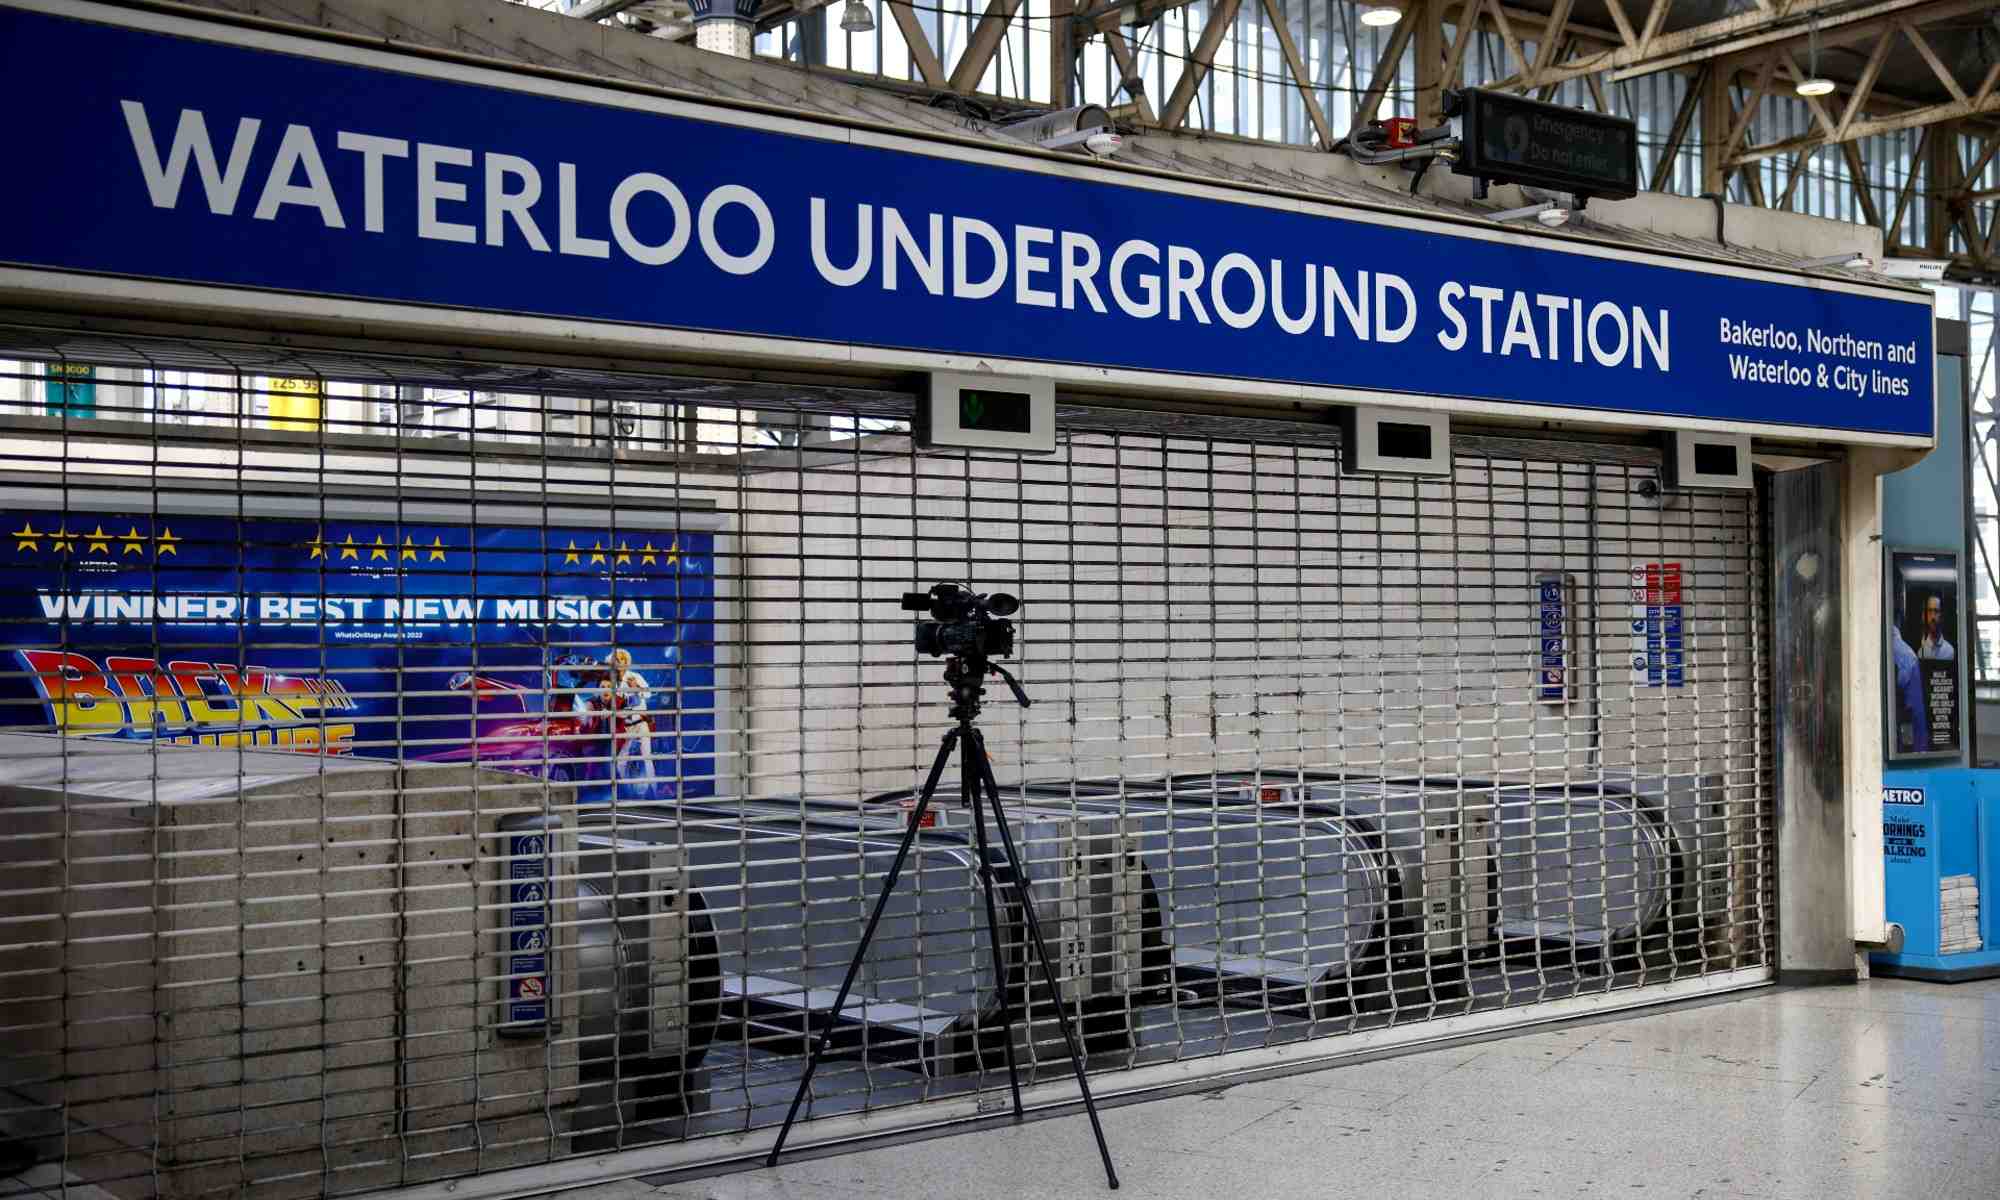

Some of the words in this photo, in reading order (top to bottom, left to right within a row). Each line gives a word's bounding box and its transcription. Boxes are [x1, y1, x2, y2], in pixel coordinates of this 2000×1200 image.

[120, 99, 775, 275] WATERLOO
[810, 197, 1417, 343] UNDERGROUND
[1437, 281, 1670, 372] STATION
[1919, 263, 1942, 272] PHILIPS
[1720, 317, 1802, 354] Bakerloo,
[1807, 328, 1883, 361] Northern
[1887, 341, 1916, 364] and
[1728, 353, 1812, 387] Waterloo
[1816, 363, 1830, 389] &
[1833, 365, 1868, 398] City
[1872, 369, 1910, 396] lines
[37, 589, 249, 626] WINNER!
[259, 592, 372, 627] BEST
[384, 597, 484, 627] NEW
[496, 596, 664, 627] MUSICAL
[1883, 823, 1926, 838] ORNINGS
[1884, 845, 1926, 857] ALKING
